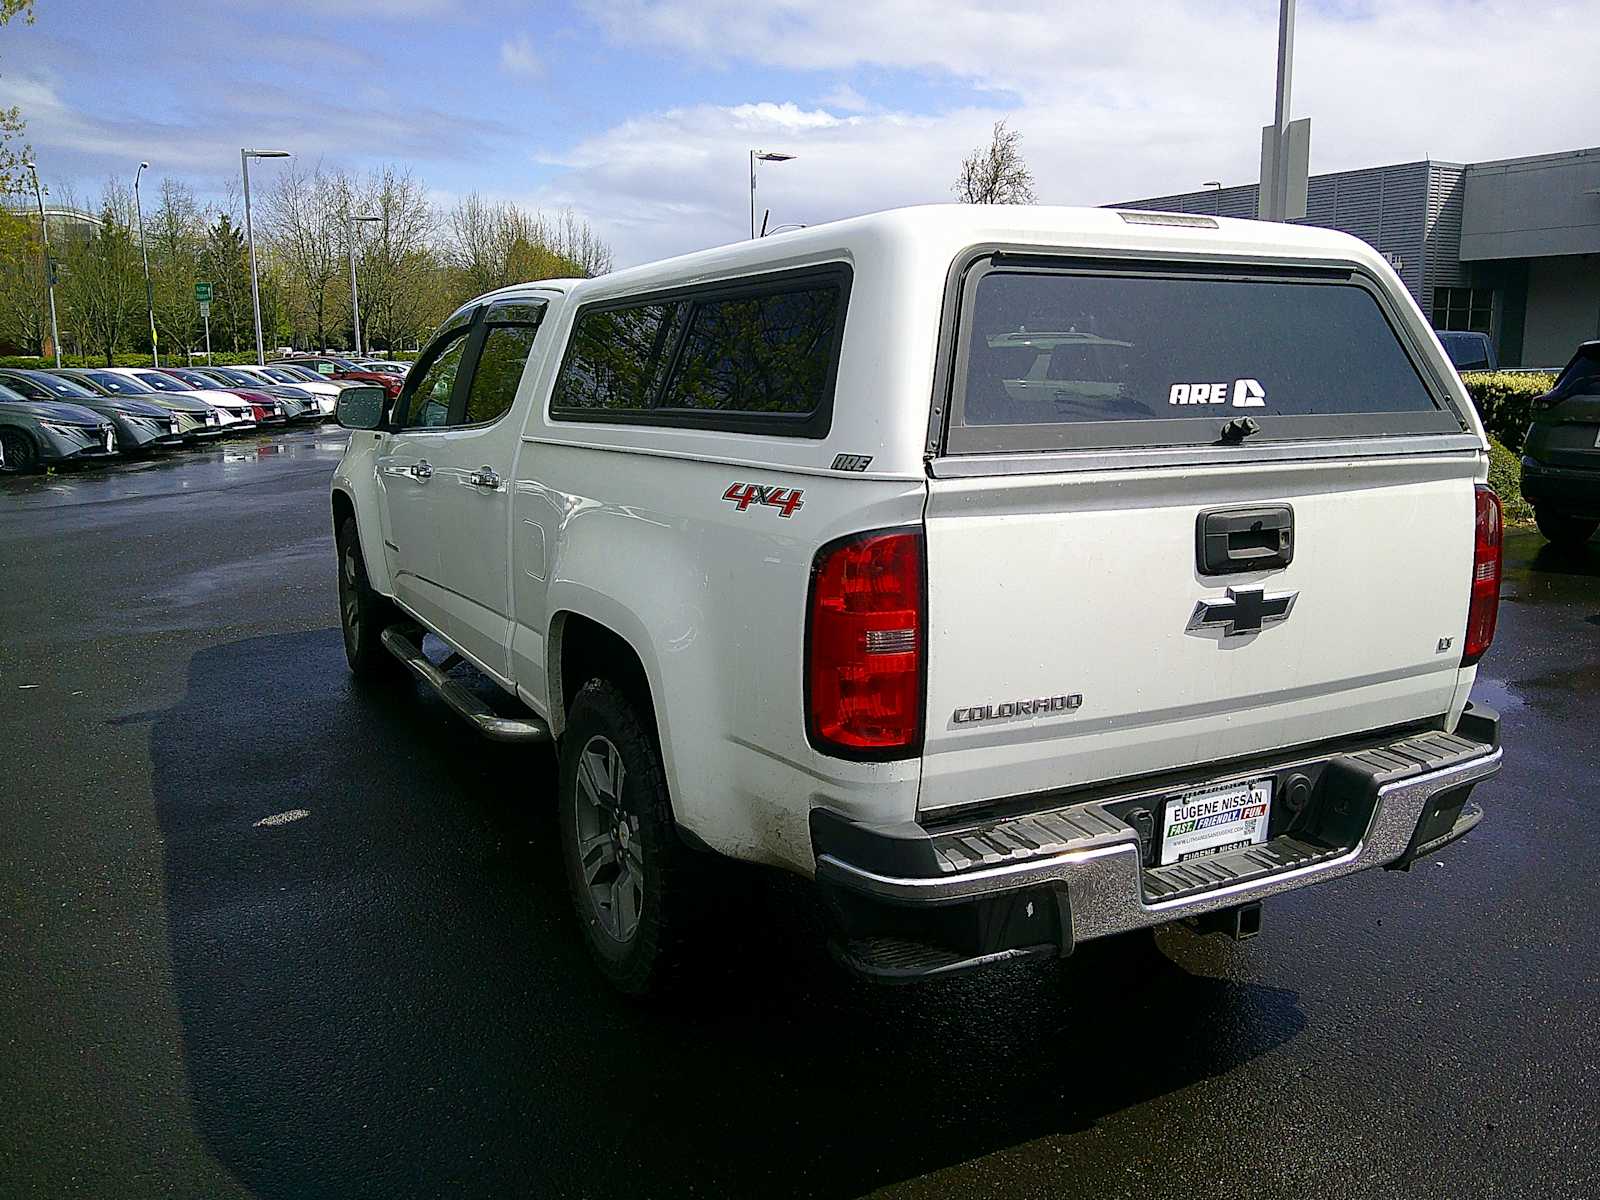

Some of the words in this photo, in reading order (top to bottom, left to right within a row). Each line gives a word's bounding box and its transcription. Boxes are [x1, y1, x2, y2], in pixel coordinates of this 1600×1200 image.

[1169, 383, 1228, 405] ARE
[832, 454, 872, 472] ARE
[952, 693, 1083, 723] COLORADO
[1174, 801, 1219, 822] EUGENE
[1221, 791, 1263, 810] NISSAN
[1169, 821, 1193, 836] FAST.
[1197, 810, 1239, 829] FRIENDLY.
